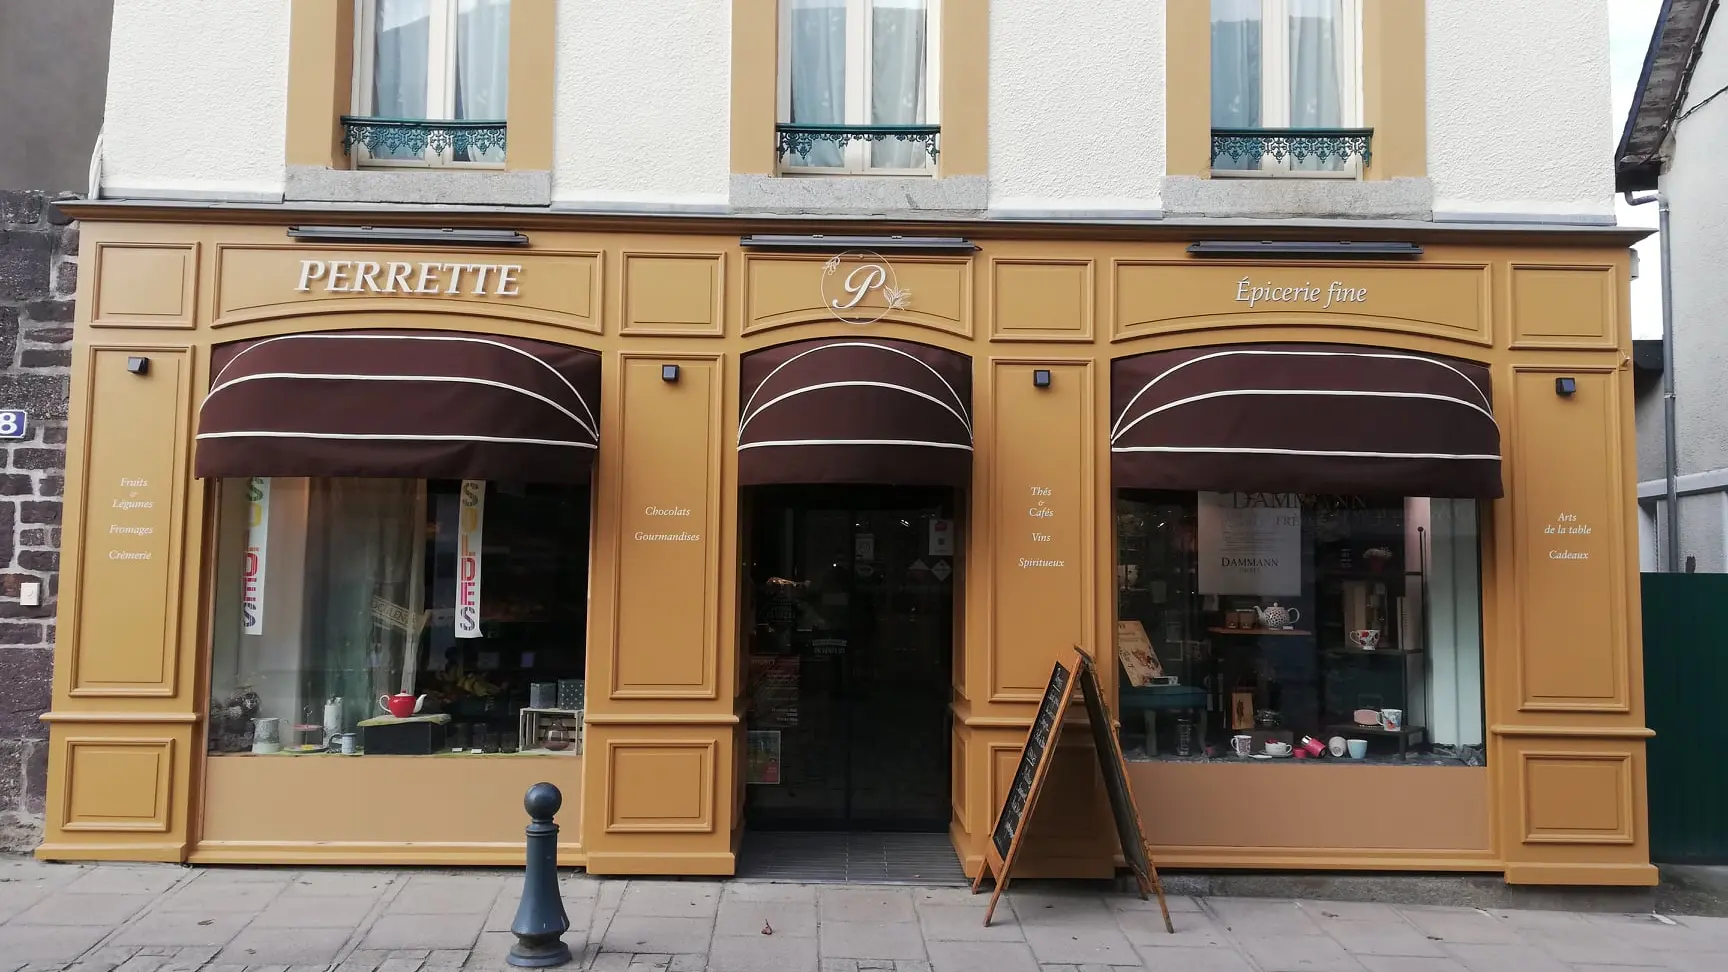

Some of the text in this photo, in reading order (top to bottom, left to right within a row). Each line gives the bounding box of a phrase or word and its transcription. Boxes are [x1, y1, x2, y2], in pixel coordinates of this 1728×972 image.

[294, 260, 522, 296] PERRETTE
[832, 264, 886, 309] P
[1236, 276, 1367, 309] Épicerie fine
[120, 478, 148, 487] Fruits
[1031, 487, 1052, 496] Thés
[112, 499, 153, 511] Légumes
[645, 506, 692, 516] Chocolats
[1029, 507, 1054, 519] Cafés
[1557, 512, 1577, 522] Arts
[109, 524, 153, 536] Fromages
[1544, 525, 1592, 534] de la table
[634, 531, 700, 541] Gourmandises
[1032, 532, 1051, 542] Vins
[460, 482, 479, 632] SOLDES
[1549, 550, 1589, 560] Cadeaux
[1018, 557, 1065, 569] Spiritueux
[1221, 557, 1279, 568] DAMMANN
